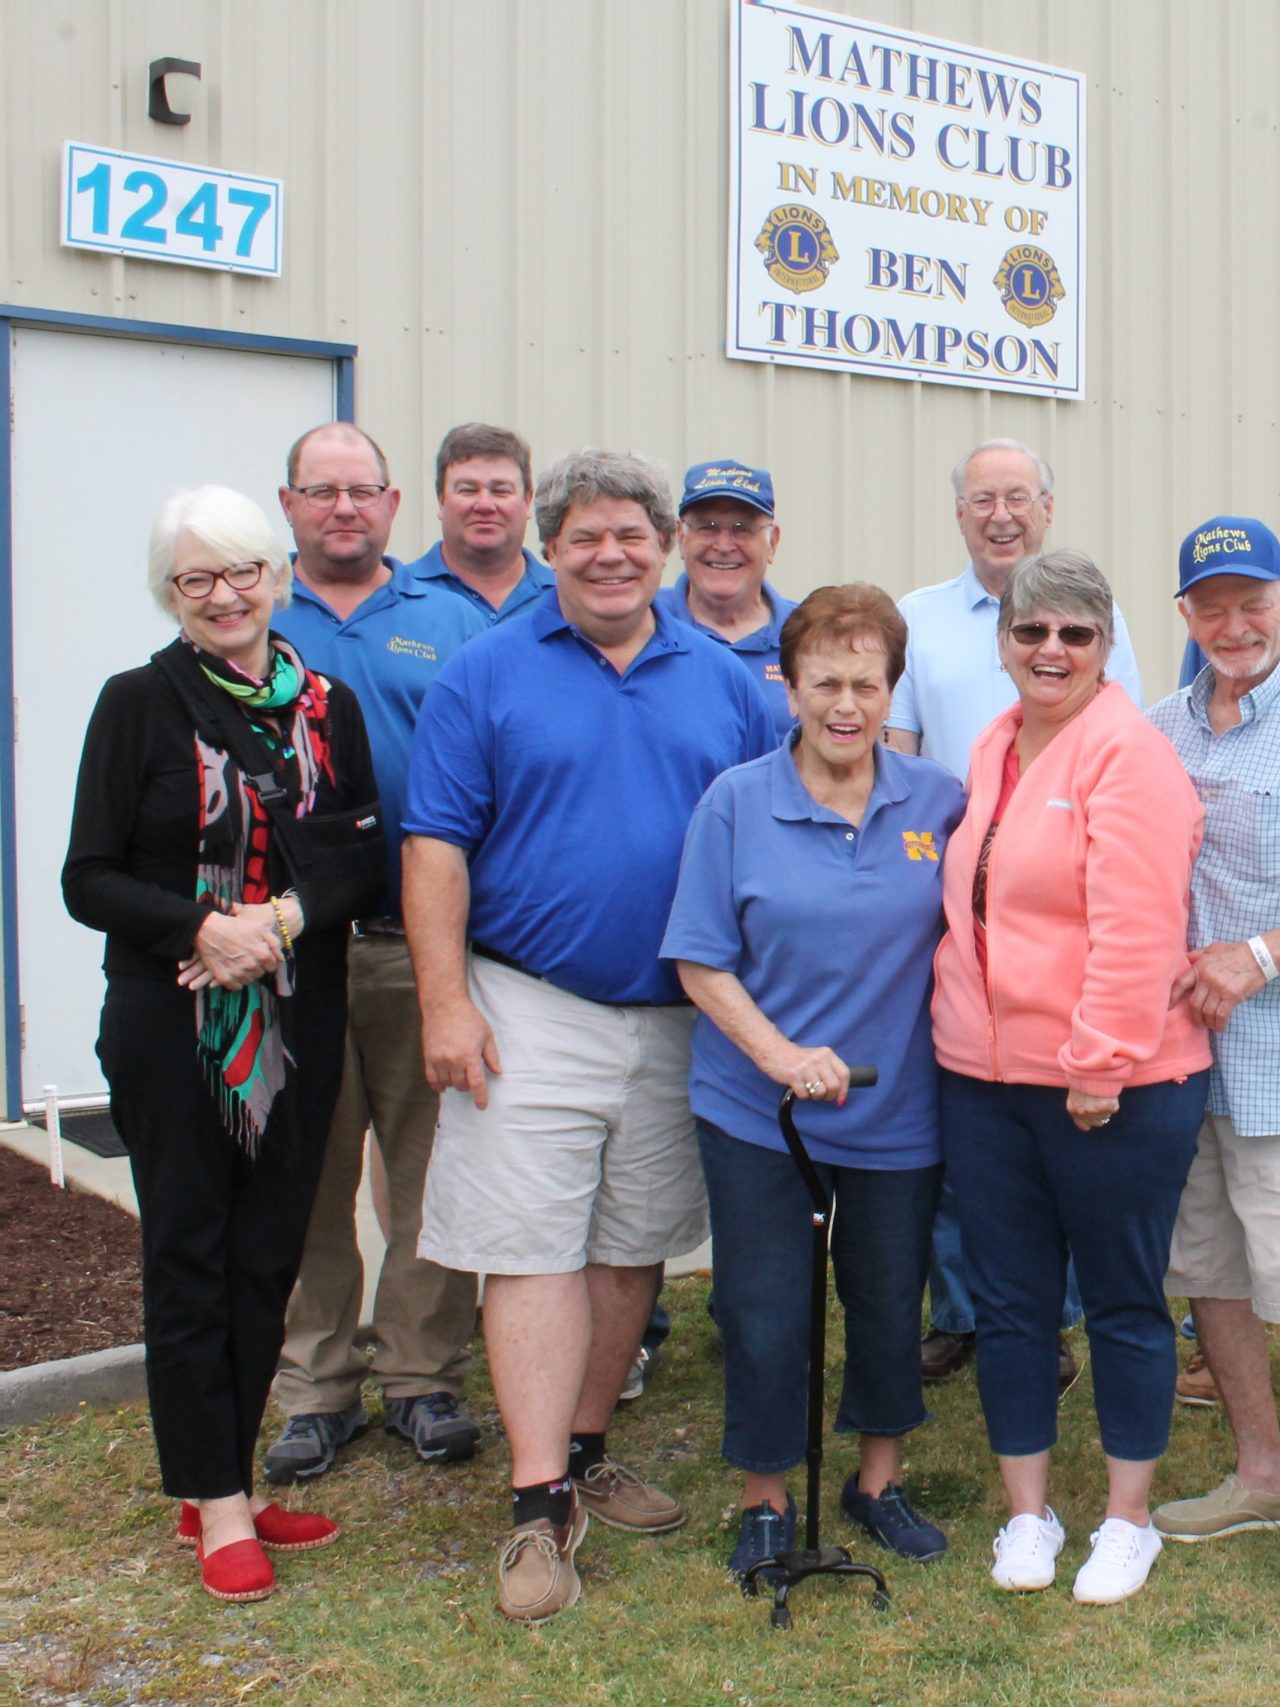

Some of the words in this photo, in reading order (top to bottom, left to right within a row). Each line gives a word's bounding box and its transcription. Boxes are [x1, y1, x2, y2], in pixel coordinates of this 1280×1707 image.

[785, 25, 1042, 126] MATHEWS
[748, 82, 916, 160] LIONS
[935, 123, 1072, 191] CLUB
[76, 163, 272, 257] 1247
[774, 207, 822, 230] LIONS
[776, 161, 818, 195] IN
[830, 171, 993, 227] MEMORY
[1004, 206, 1049, 236] OF
[788, 230, 810, 264] L
[1009, 247, 1051, 268] LIONS
[865, 247, 969, 302] BEN
[1022, 269, 1041, 300] L
[759, 301, 1061, 381] THOMPSON
[1193, 543, 1221, 564] Lions
[1223, 538, 1252, 553] Club
[1195, 527, 1247, 544] Mathews
